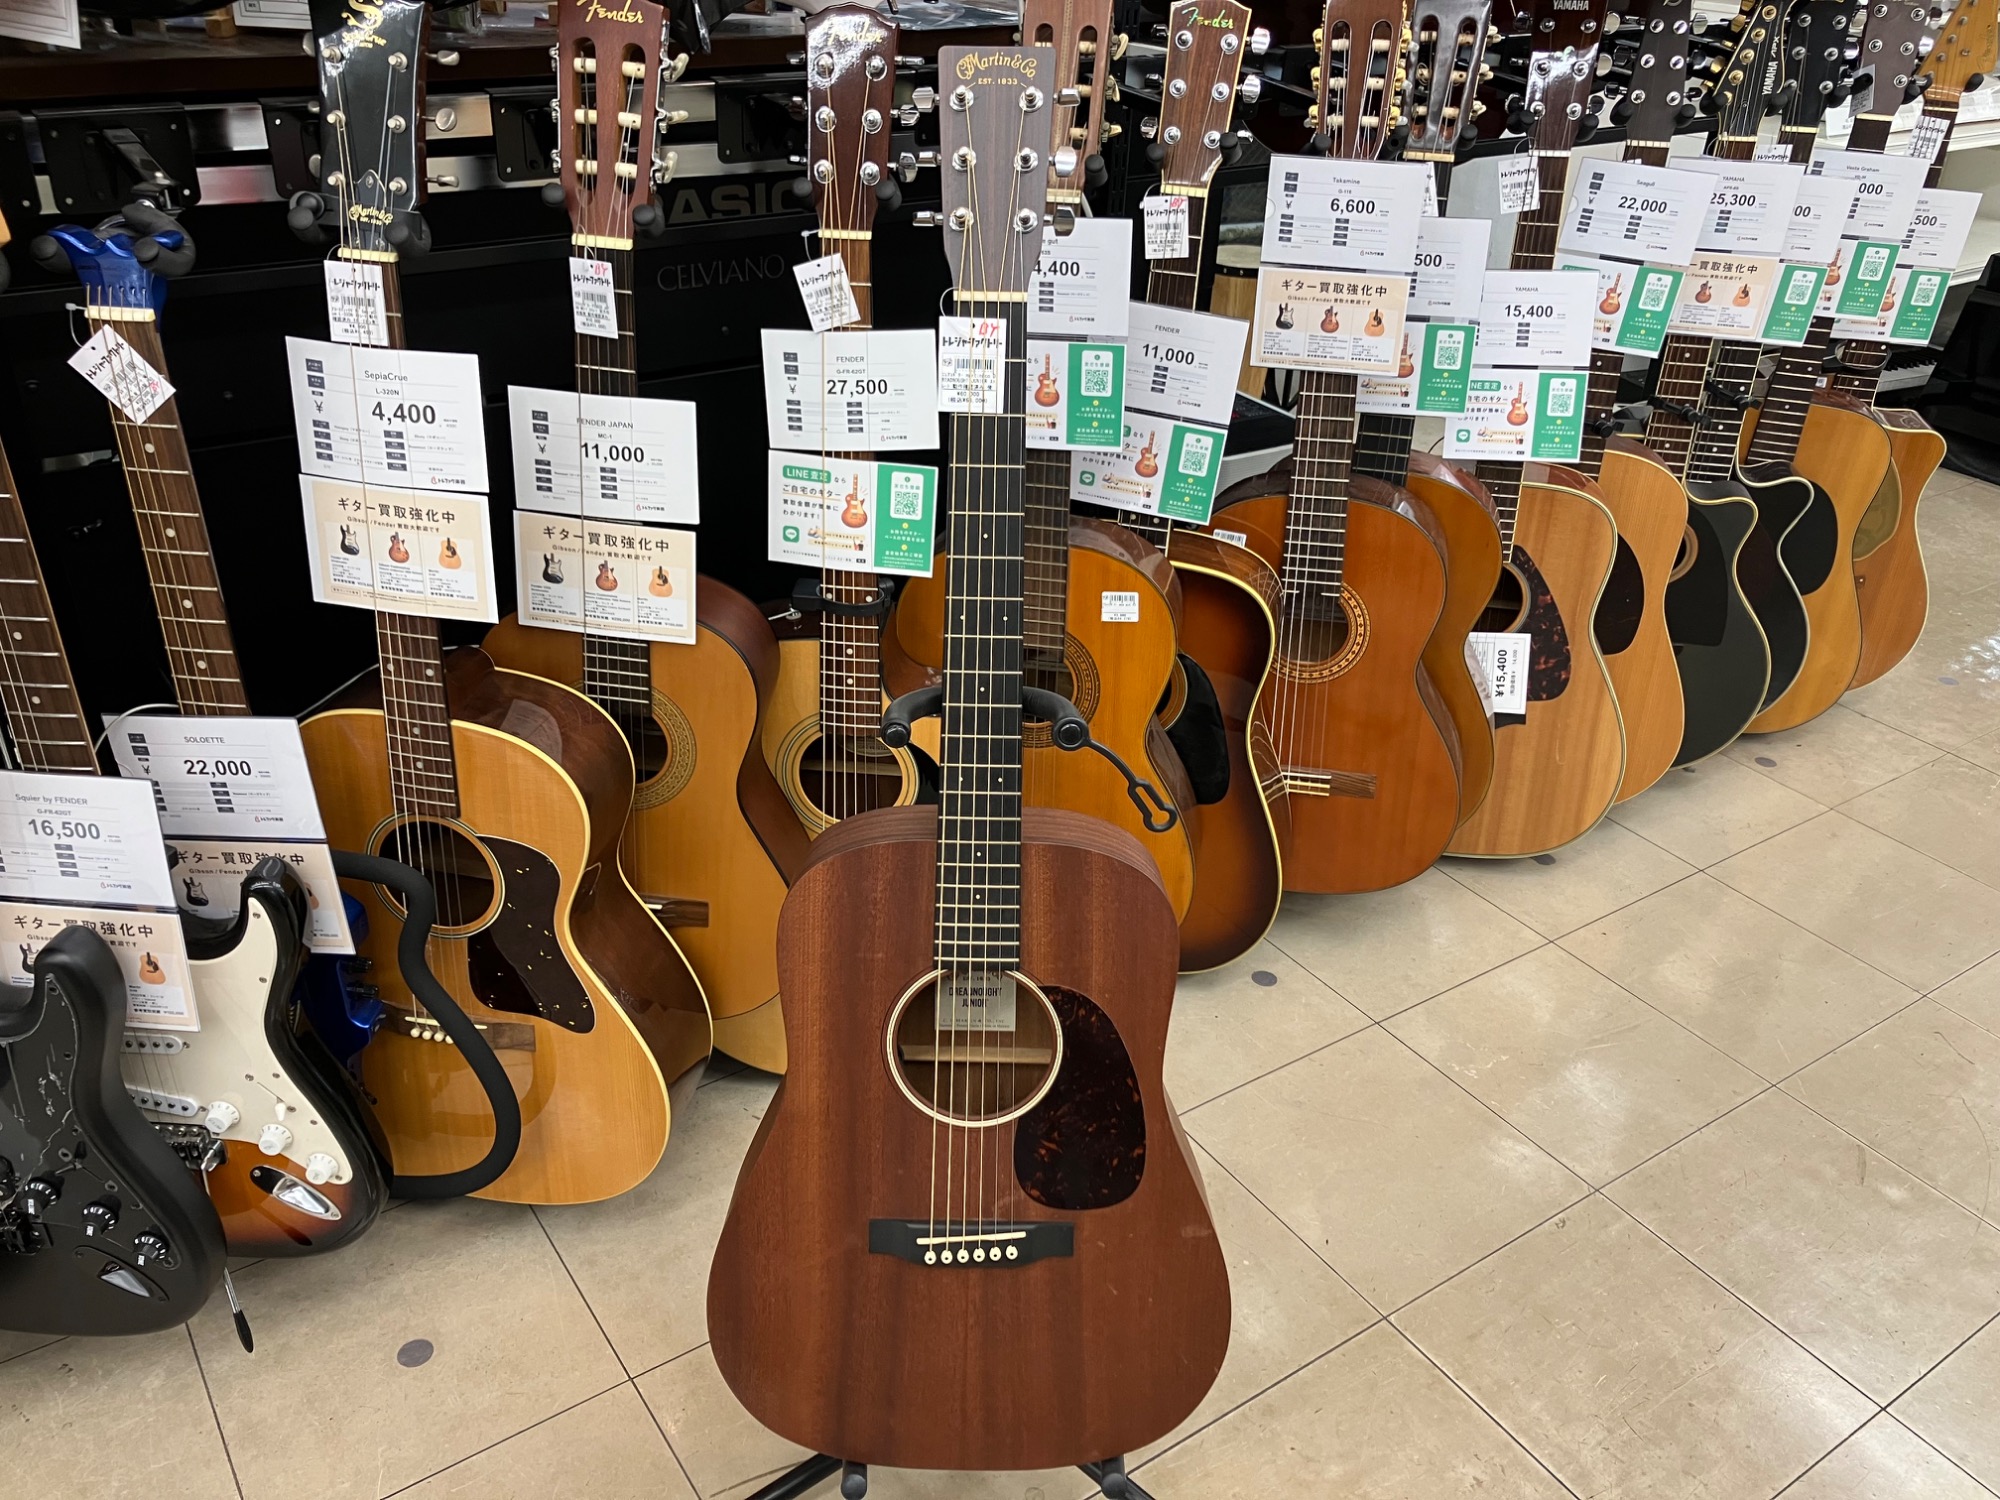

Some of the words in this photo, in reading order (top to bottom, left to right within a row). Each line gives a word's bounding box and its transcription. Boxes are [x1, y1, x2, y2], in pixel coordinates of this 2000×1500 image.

[576, 0, 644, 24] Fender
[1553, 0, 1589, 11] YAMAHA
[997, 77, 1018, 85] 1833
[1761, 61, 1778, 95] YAMAHA
[1330, 197, 1376, 215] 6,600
[1617, 195, 1668, 214] 22,000
[657, 254, 785, 292] CELVIANO
[1281, 278, 1388, 298] ギター買取強化中
[1504, 304, 1554, 320] 15,400
[1154, 324, 1181, 335] FENDER
[836, 355, 865, 364] FENDER
[1142, 343, 1195, 366] 11,000
[364, 370, 408, 383] SepiaCrue
[375, 387, 400, 397] L-320N
[826, 379, 889, 399] 27,500
[371, 400, 437, 426] 4,400
[608, 420, 634, 430] JAPAN
[597, 432, 613, 441] MC-1
[580, 442, 645, 463] 11,000
[337, 496, 457, 526] ギター買取強化中
[542, 525, 670, 553] ギター買取強化中
[1494, 649, 1508, 697] ¥15,400
[183, 735, 226, 745] SOLOETTE
[183, 759, 252, 778] 22,000
[15, 793, 41, 803] Squier
[43, 795, 52, 804] by
[54, 796, 88, 805] FENDER
[28, 818, 101, 841] 16,500
